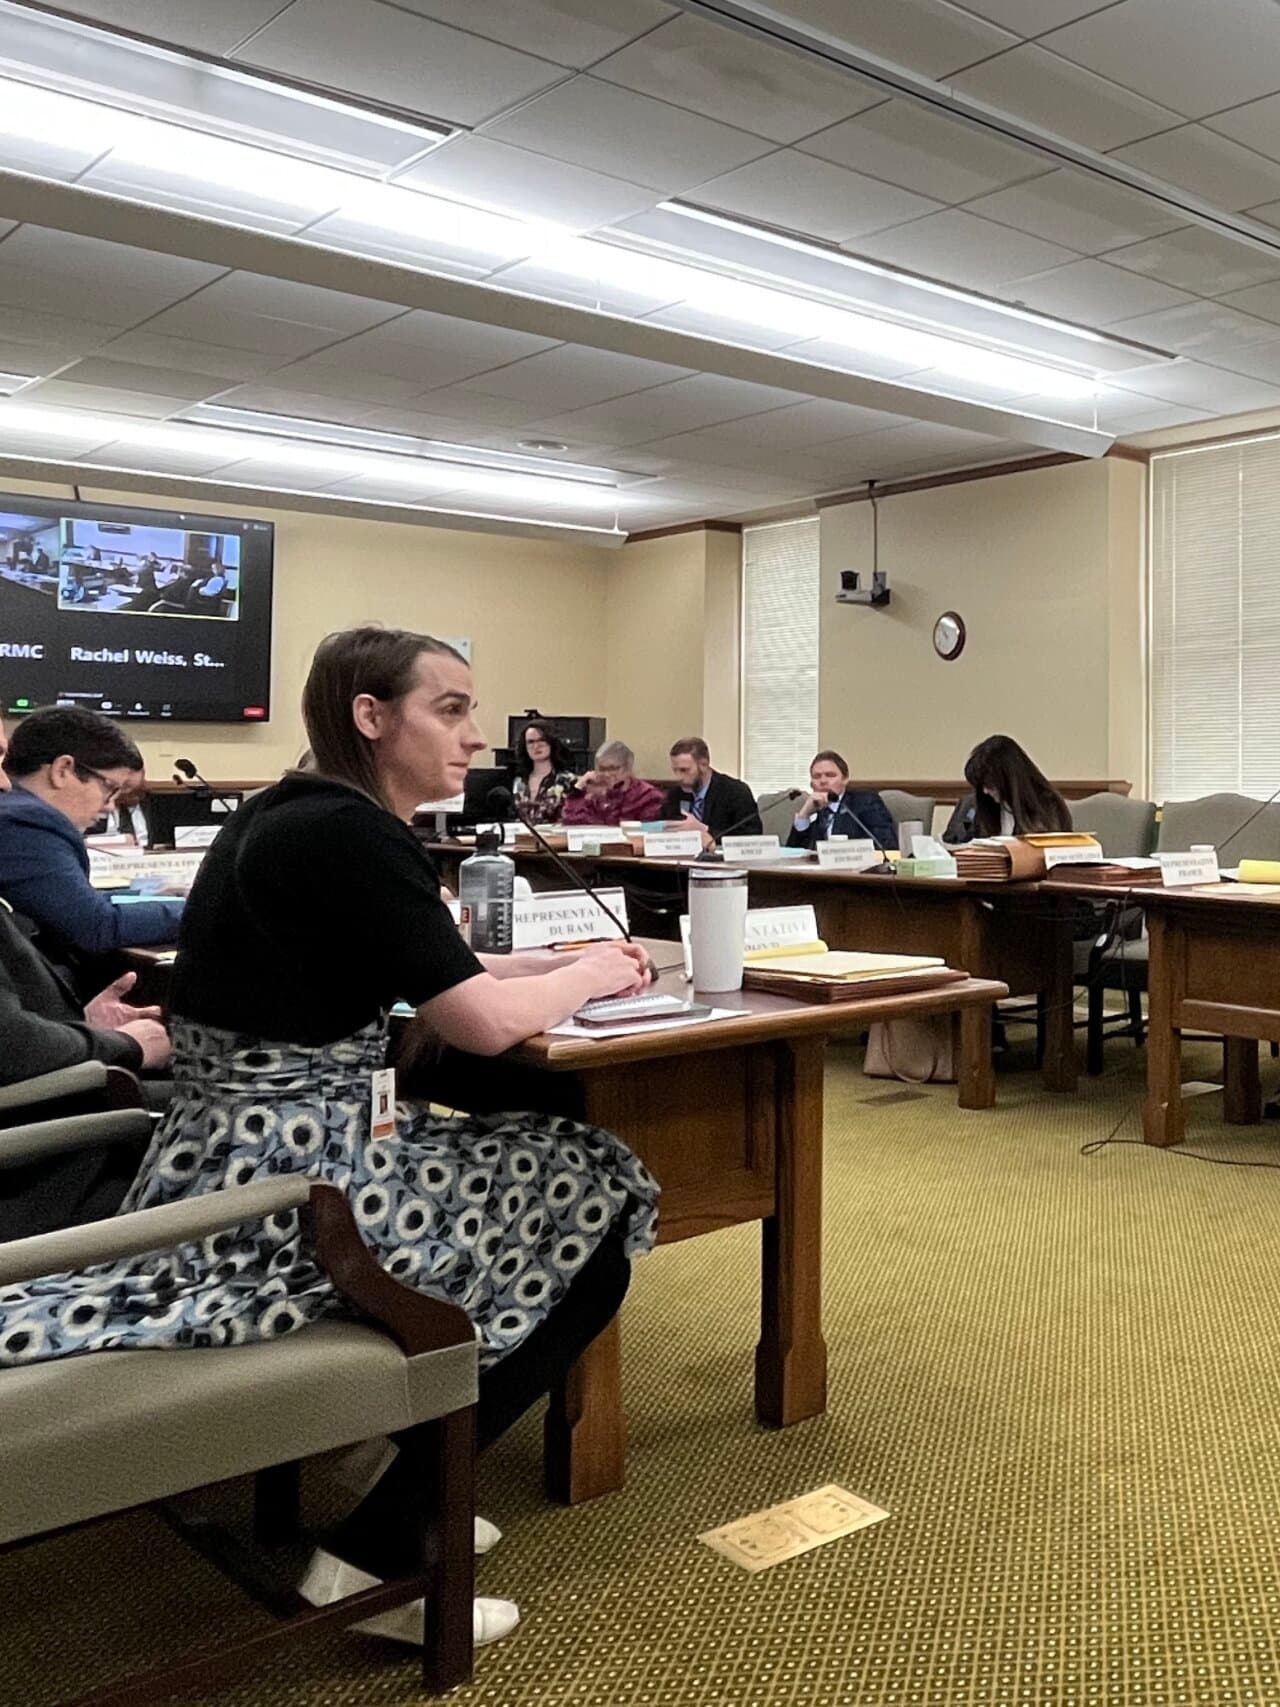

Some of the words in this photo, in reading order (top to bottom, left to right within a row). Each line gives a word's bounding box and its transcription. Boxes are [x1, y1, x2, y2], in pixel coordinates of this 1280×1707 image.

[70, 646, 129, 663] Rachel
[135, 650, 188, 667] Weiss,
[514, 904, 622, 924] REPRESENTATE
[550, 922, 595, 937] DURAM
